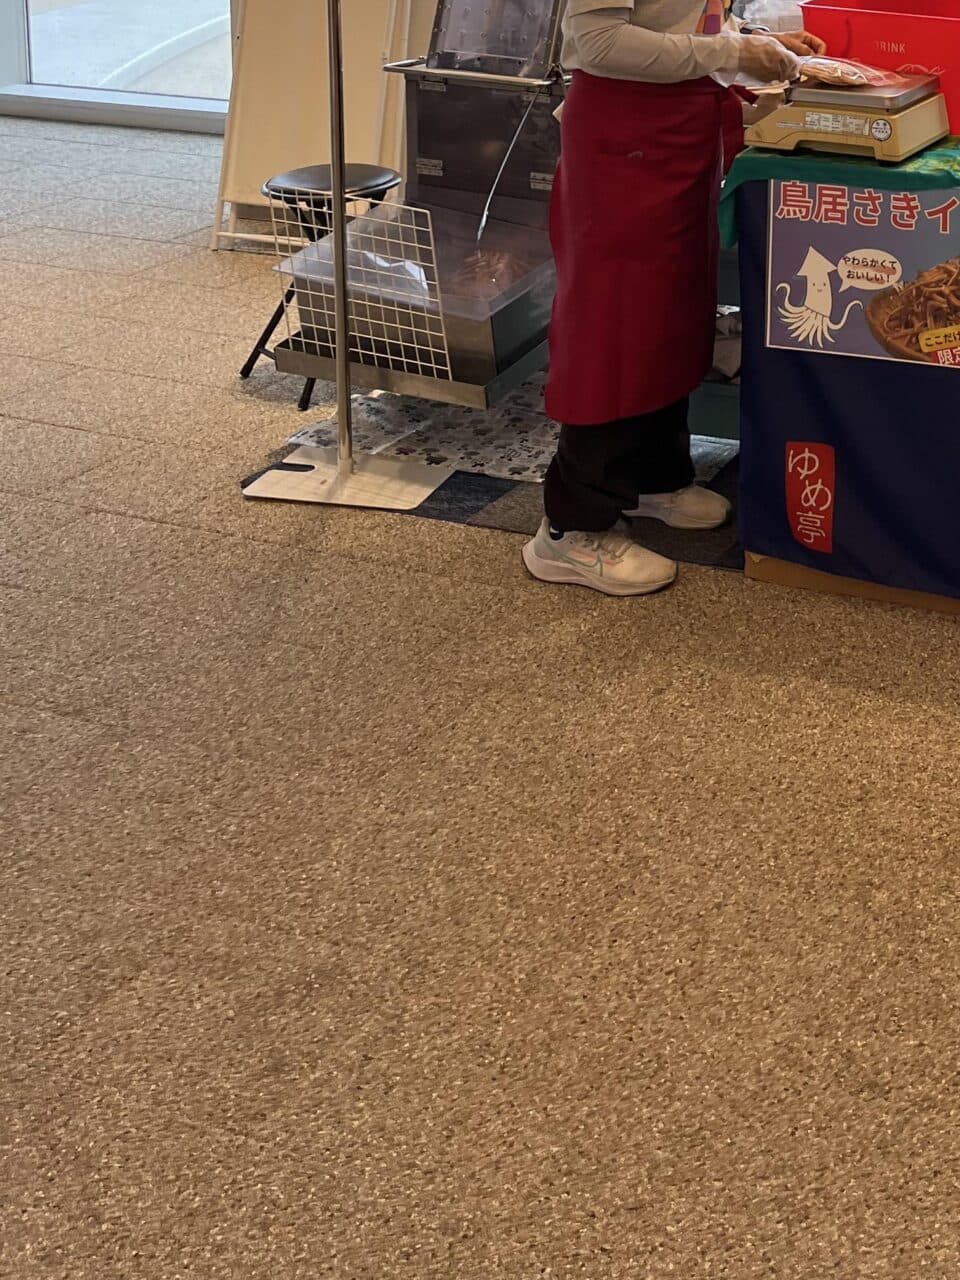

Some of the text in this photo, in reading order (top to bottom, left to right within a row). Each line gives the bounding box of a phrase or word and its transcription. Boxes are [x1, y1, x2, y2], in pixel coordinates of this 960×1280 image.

[842, 255, 897, 270] やわらかくて
[787, 447, 832, 544] ゆめ亭
